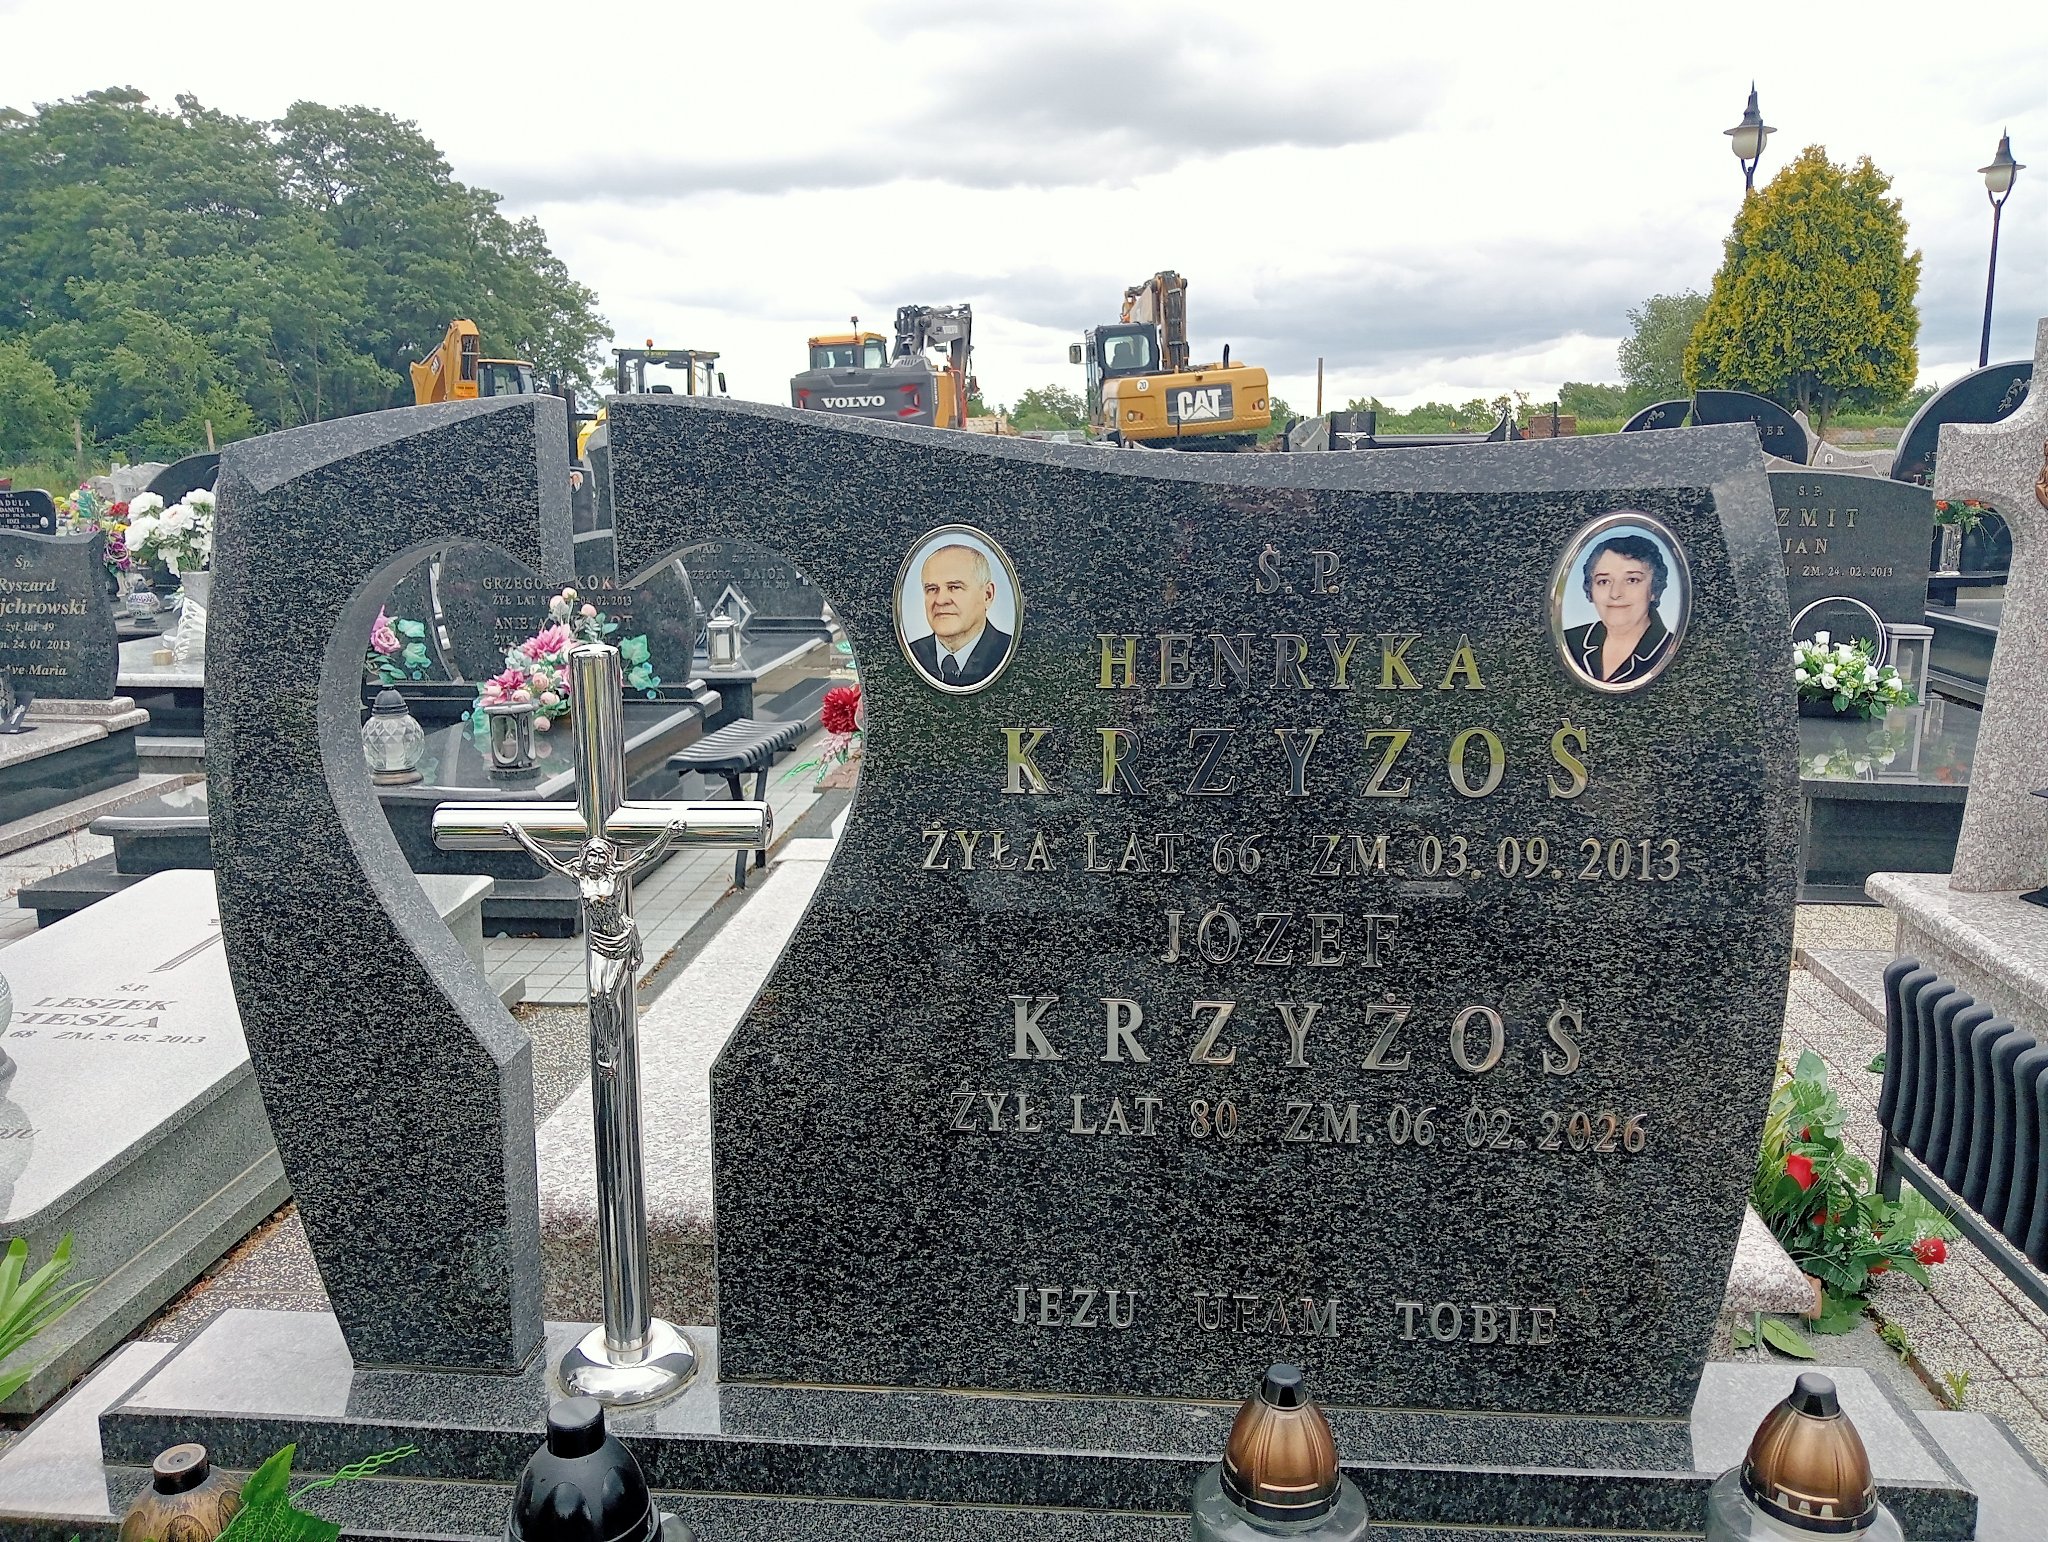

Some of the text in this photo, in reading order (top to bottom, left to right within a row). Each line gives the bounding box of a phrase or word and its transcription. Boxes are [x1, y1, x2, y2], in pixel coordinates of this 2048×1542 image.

[821, 395, 886, 408] VOLVO
[1177, 389, 1222, 420] CAT
[1783, 538, 1829, 555] JAN
[1802, 566, 1824, 577] ZM.
[1870, 566, 1893, 577] 2013
[517, 595, 536, 606] LAT
[612, 595, 632, 606] 2013
[42, 621, 55, 632] 49
[47, 639, 71, 650] 2013
[29, 664, 68, 676] Maria
[1096, 634, 1486, 691] HENRYKA
[1000, 715, 1589, 799] KRZYŻOŚ
[922, 822, 1057, 871] ŻYŁA
[1083, 832, 1186, 873] LAT
[1212, 833, 1263, 875] 66
[1578, 838, 1681, 882] 2013
[1161, 902, 1399, 968] JÓZEF
[32, 997, 178, 1011] LESZEK
[53, 1031, 94, 1040] ZM.
[156, 1035, 206, 1044] 2013
[1007, 993, 1583, 1075] KRZYŻOŚ
[950, 1081, 1042, 1133] ŻYŁ
[1069, 1093, 1163, 1136] LAT
[1190, 1099, 1239, 1140] 80
[1284, 1103, 1374, 1144] ZM.
[1538, 1110, 1647, 1152] 2026
[1012, 1286, 1557, 1345] JEZU UFAM TOBIE
